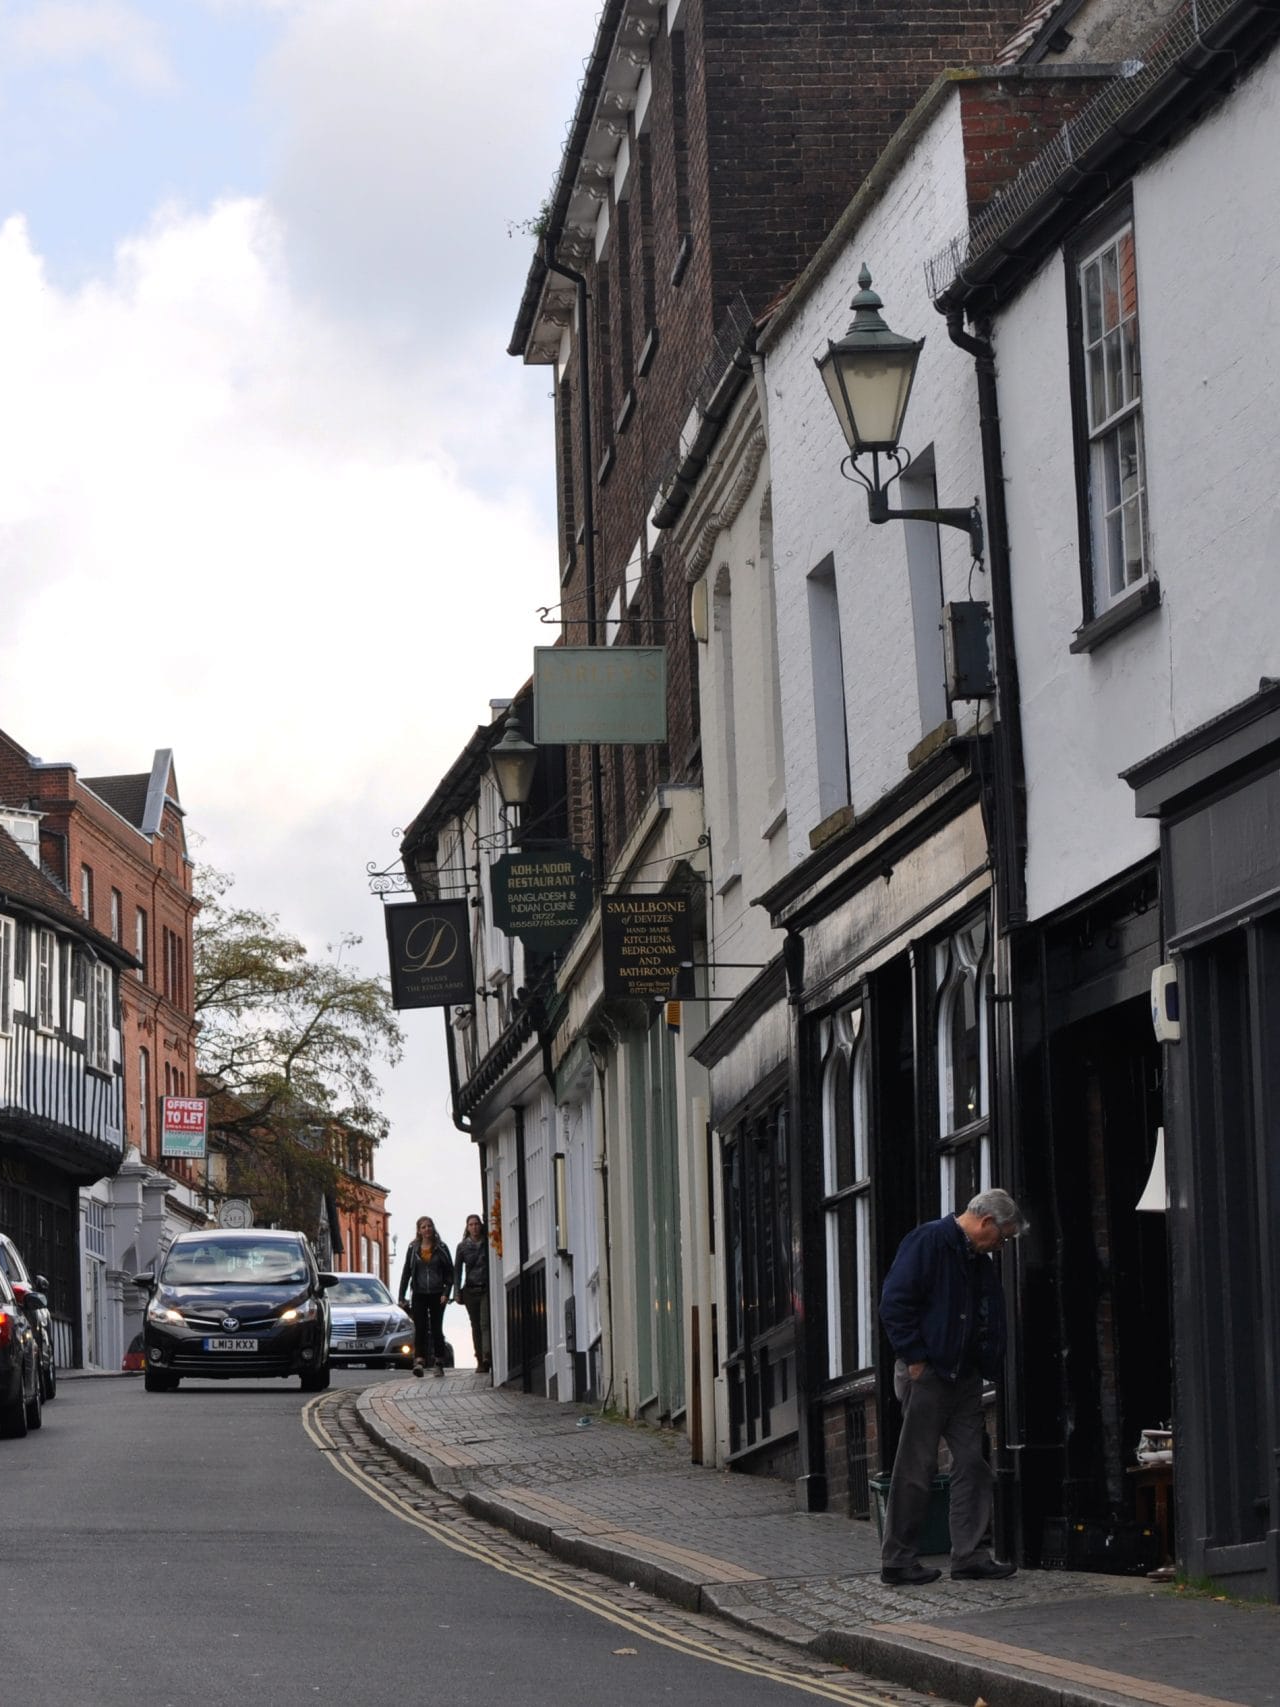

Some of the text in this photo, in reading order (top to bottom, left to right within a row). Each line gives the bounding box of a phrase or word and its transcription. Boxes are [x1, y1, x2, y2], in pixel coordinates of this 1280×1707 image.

[510, 862, 572, 875] KOH-I-NOOR
[507, 875, 576, 889] RESTAURANT
[507, 891, 577, 903] BANGLADESHI &
[511, 901, 576, 913] INDIAN CUISINE
[606, 901, 686, 913] SMALLBONE
[634, 914, 673, 923] DEVIZES
[401, 913, 458, 972] D
[623, 935, 672, 944] KITCHENS
[621, 945, 677, 955] BEDROOMS
[638, 956, 661, 965] AND
[619, 967, 680, 977] BATHROOMS
[167, 1100, 204, 1110] OFFICES
[166, 1110, 204, 1124] TO LET
[212, 1339, 255, 1350] LM13 KXX
